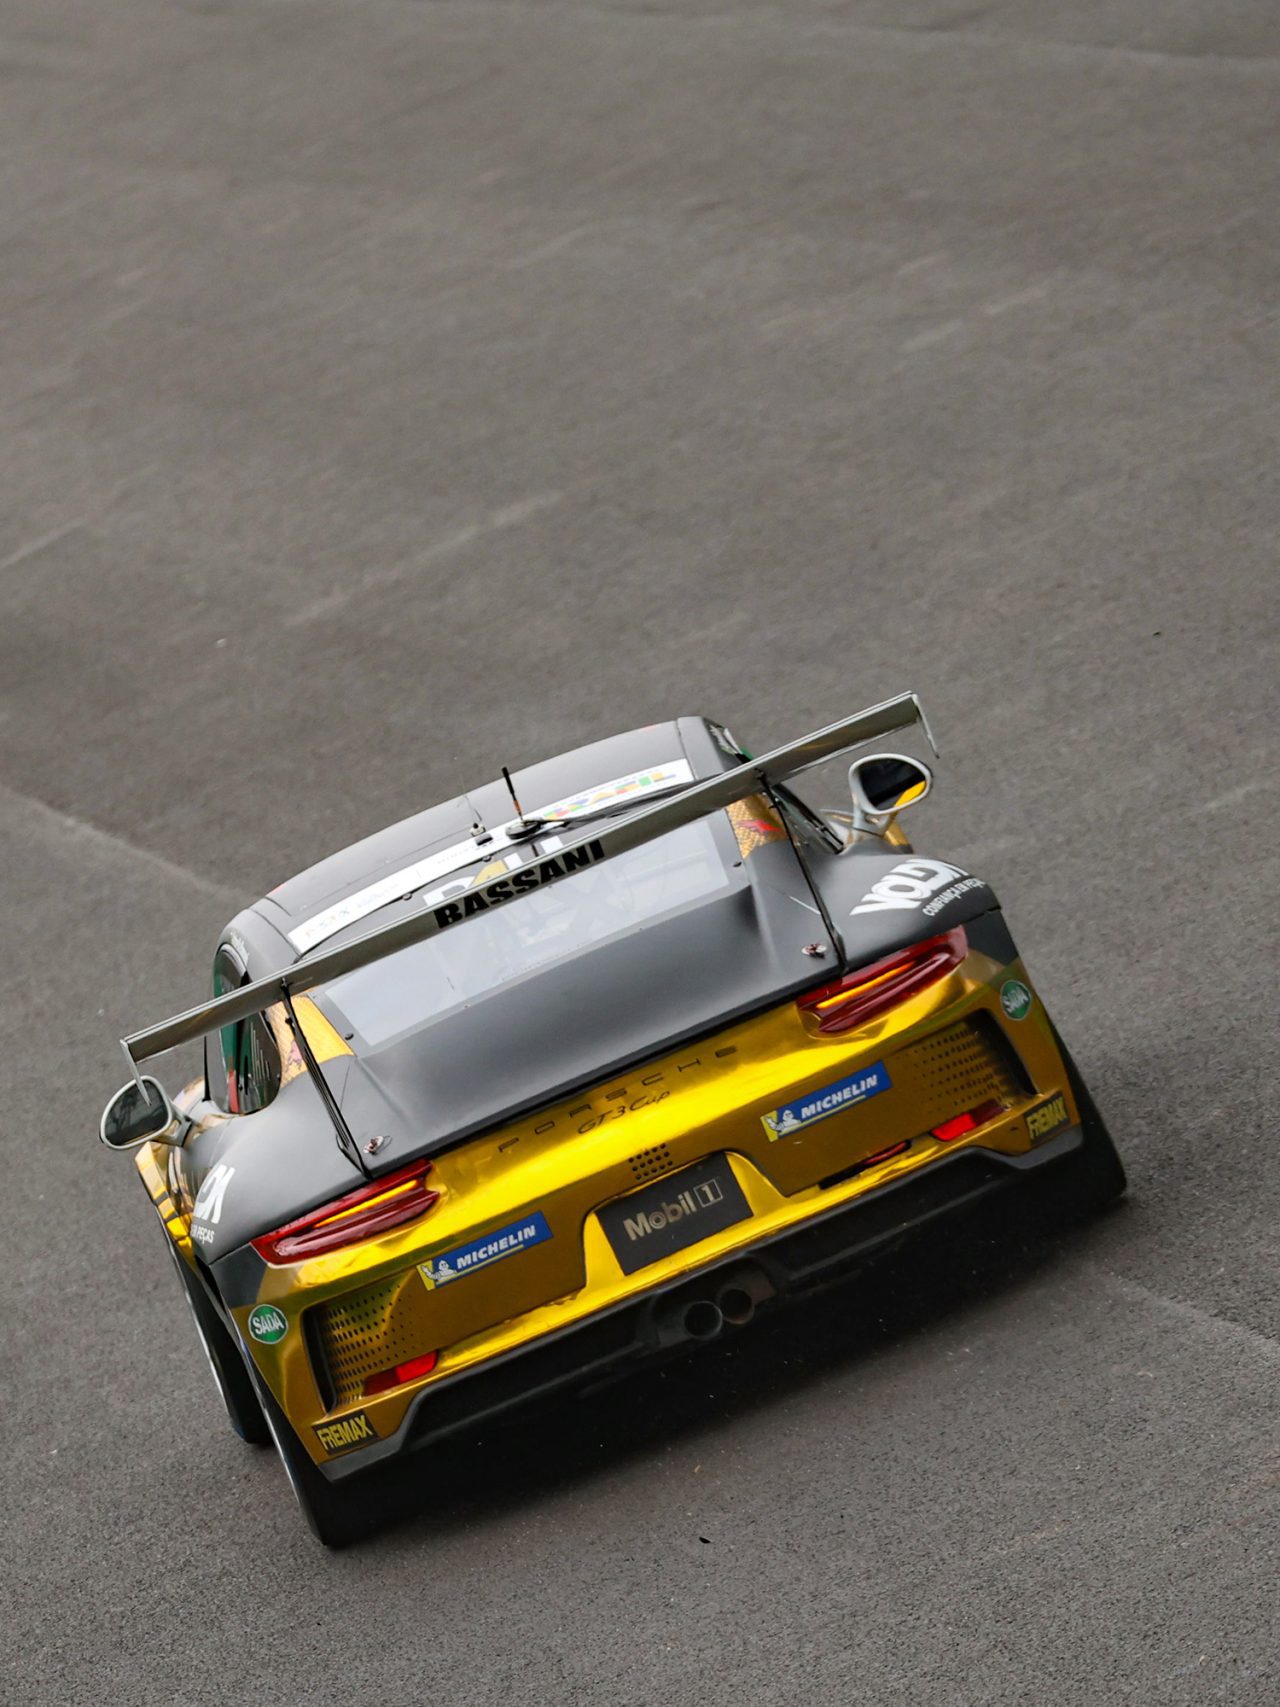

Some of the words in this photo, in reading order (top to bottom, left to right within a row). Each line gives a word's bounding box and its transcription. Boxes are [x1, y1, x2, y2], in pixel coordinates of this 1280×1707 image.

[433, 840, 605, 929] BASSANI
[498, 1046, 737, 1153] PORSCHE
[629, 1090, 670, 1112] Cup
[801, 1074, 878, 1119] MICHELIN
[623, 1190, 697, 1241] Mobil
[457, 1224, 536, 1269] MICHELIN
[252, 1311, 285, 1335] SADA
[317, 1414, 373, 1450] FREMAX
